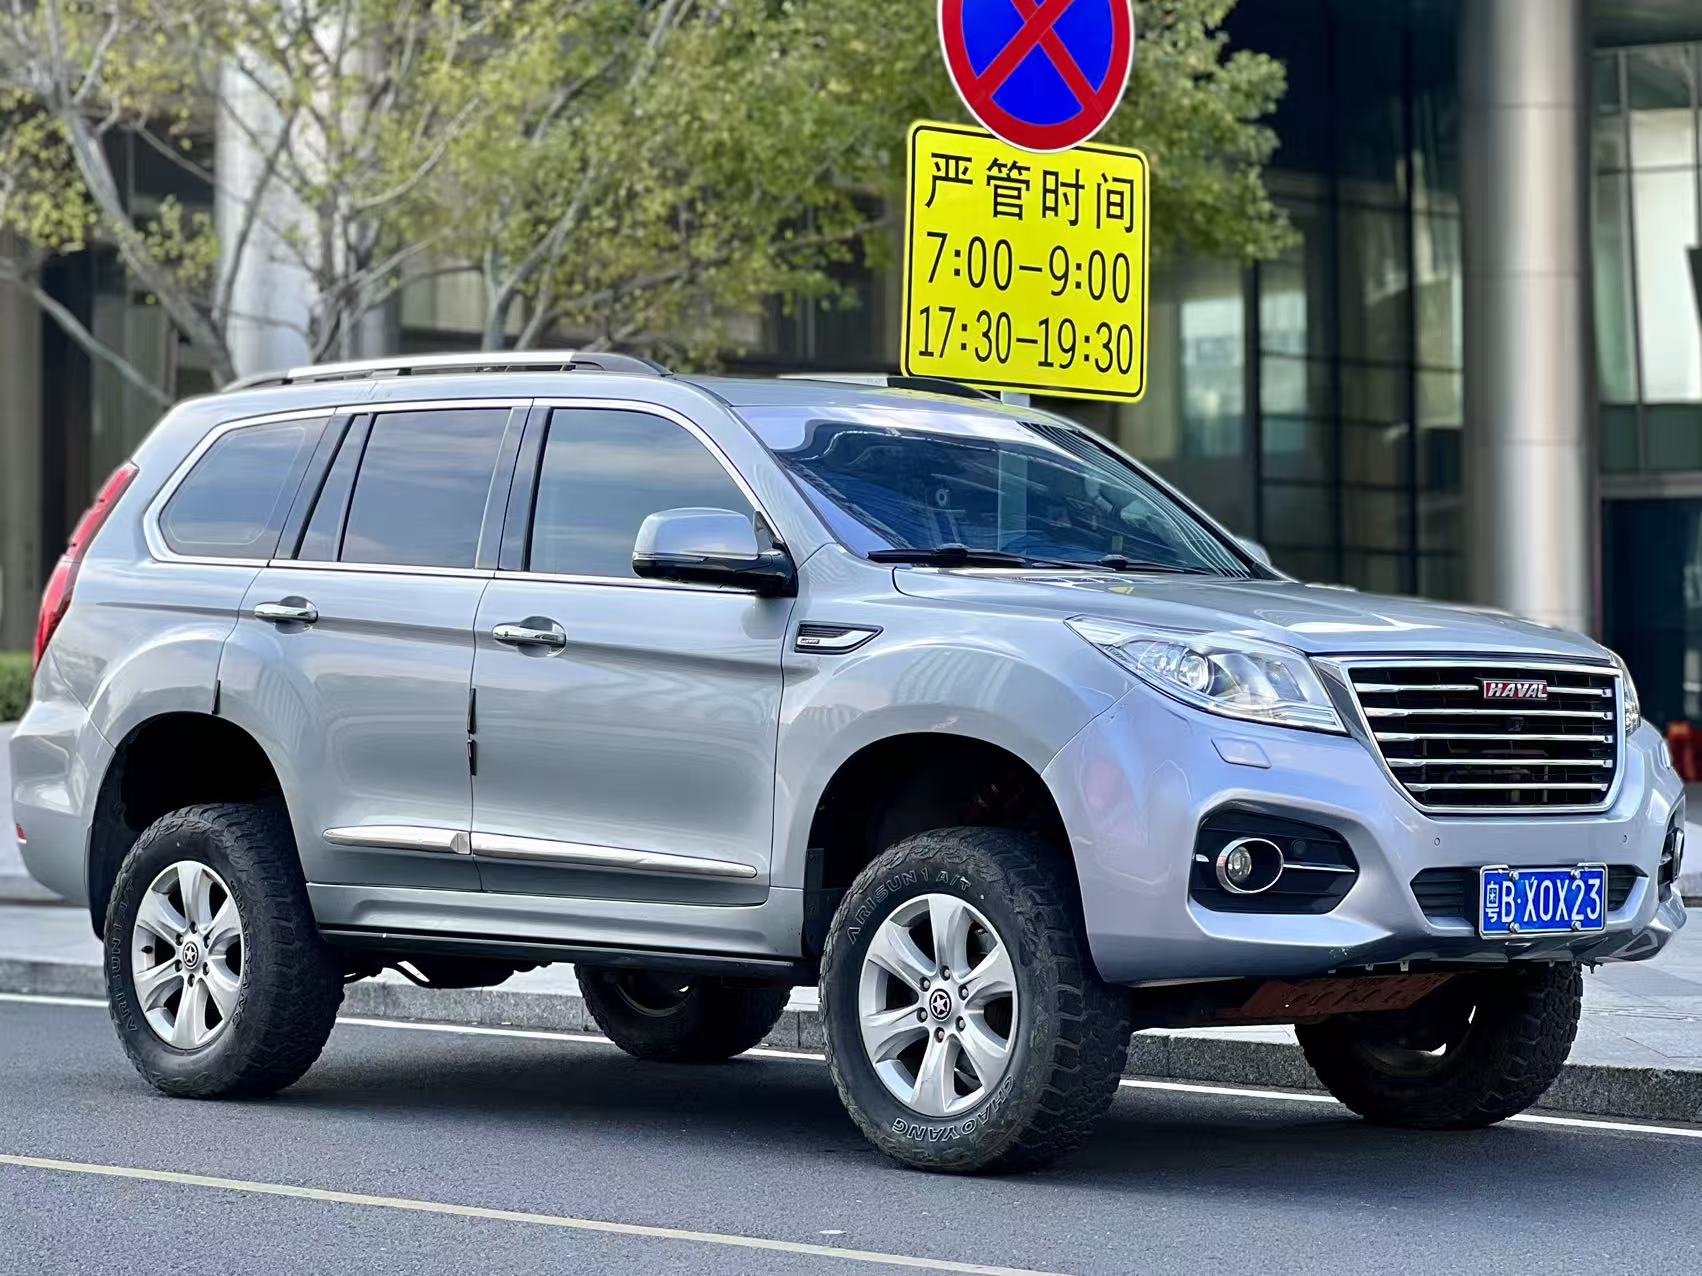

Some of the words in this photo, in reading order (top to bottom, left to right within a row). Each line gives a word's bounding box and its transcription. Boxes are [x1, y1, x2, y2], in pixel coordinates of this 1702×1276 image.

[925, 152, 1135, 233] 严管时间
[1487, 682, 1547, 698] HAVAL
[847, 869, 918, 945] ARISUN
[891, 1074, 1014, 1142] CHAOYANG
